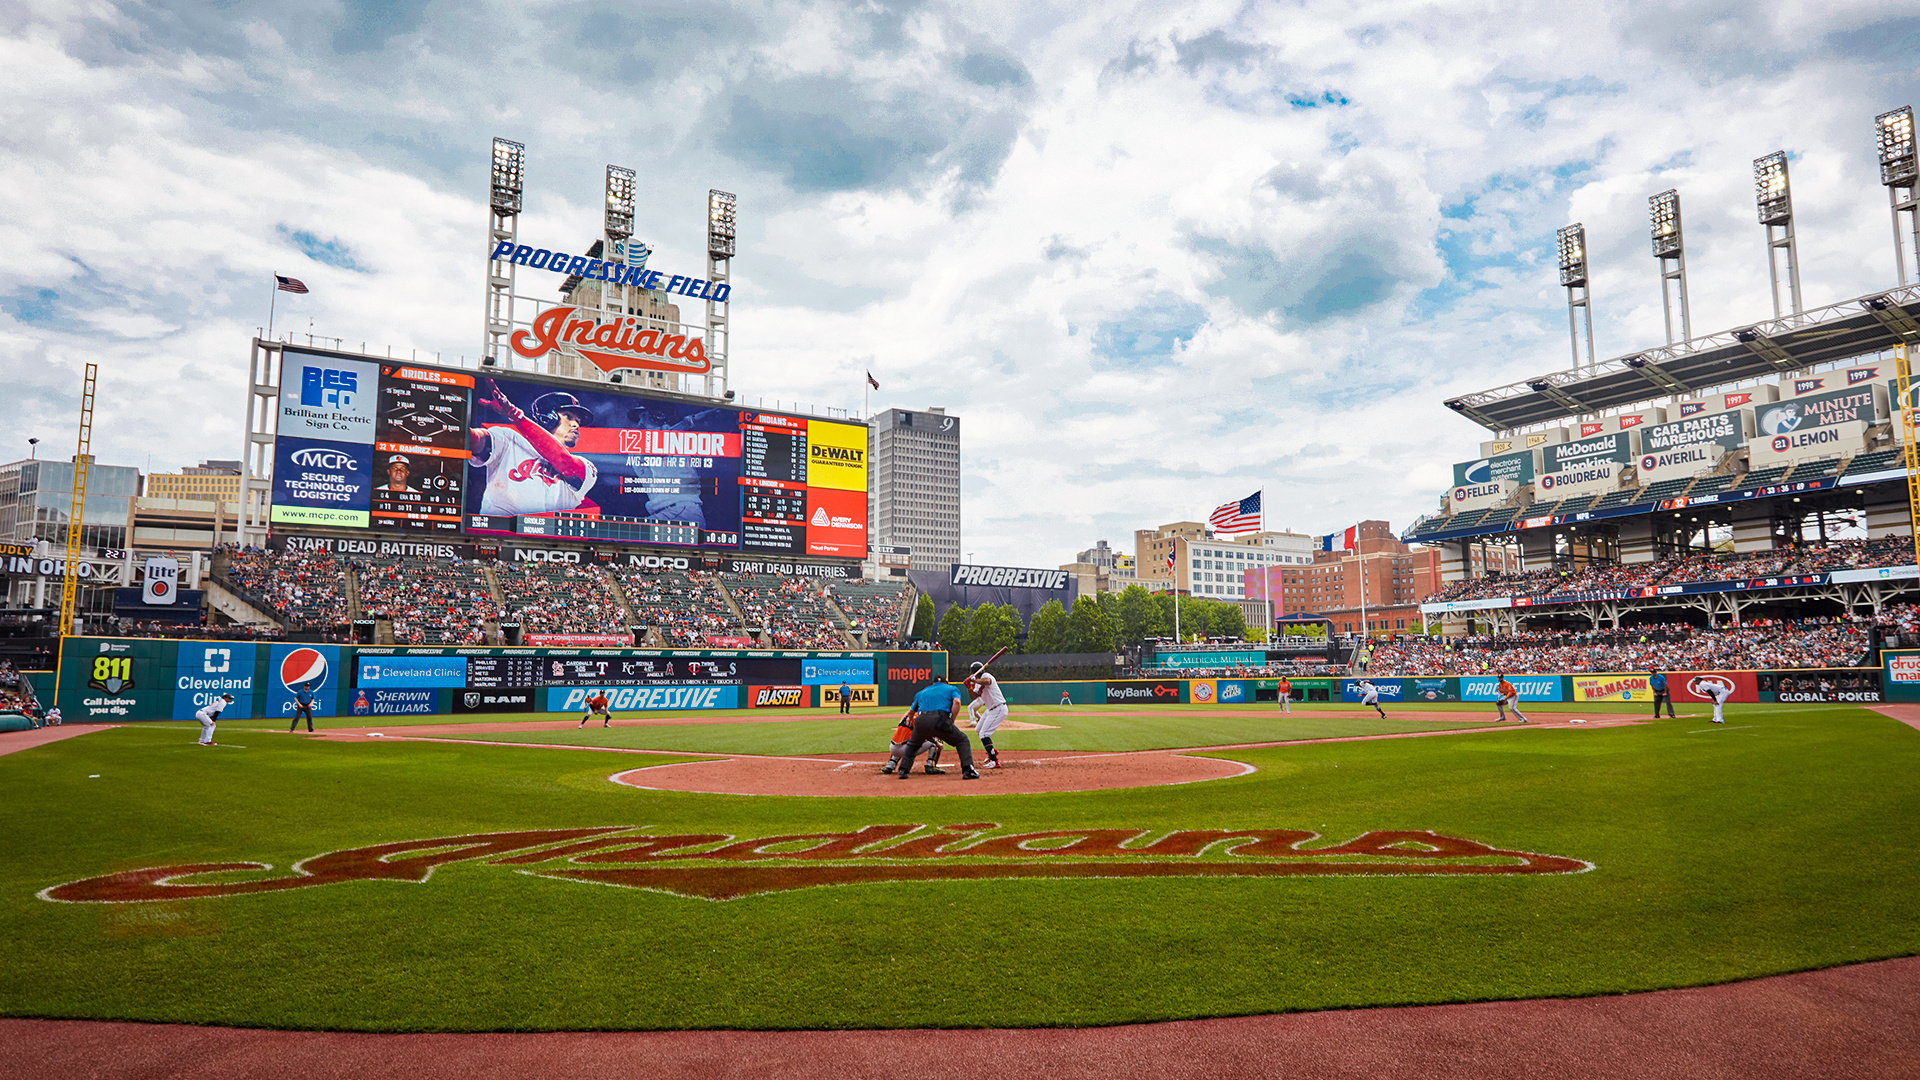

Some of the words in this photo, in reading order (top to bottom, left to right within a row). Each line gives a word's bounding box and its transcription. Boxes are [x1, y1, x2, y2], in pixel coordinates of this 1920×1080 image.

[490, 240, 664, 290] PROGRESSIVE
[665, 274, 732, 303] FIELD
[510, 306, 711, 374] Indians
[401, 368, 440, 382] ORIOLES
[1850, 370, 1868, 380] 1999
[1797, 381, 1815, 390] 1998
[1726, 395, 1742, 405] 1997
[1804, 392, 1872, 416] MINUTE
[284, 406, 329, 420] Brilliant
[331, 411, 372, 425] Electric
[1682, 404, 1697, 414] 1996
[759, 414, 787, 426] INDIANS
[1621, 418, 1636, 426] 1995
[1819, 407, 1858, 426] MEN
[305, 418, 330, 432] Sign
[332, 421, 350, 432] Co.
[939, 418, 954, 432] 9
[1583, 425, 1596, 433] 1954
[1652, 424, 1680, 438] CAR
[1683, 414, 1729, 432] PARTS
[618, 429, 642, 453] 12
[651, 431, 725, 456] LINDOR
[1650, 424, 1734, 448] WAREHOUSE
[1775, 439, 1787, 449] 21
[1791, 428, 1839, 448] LEMON
[1556, 435, 1616, 458] McDonald
[626, 456, 641, 467] AVG
[641, 457, 662, 468] .300
[666, 457, 677, 467] HR
[679, 457, 685, 467] 5
[690, 457, 702, 468] RBI
[703, 458, 713, 468] 13
[811, 459, 844, 467] GUARANTEED
[1490, 458, 1521, 469] electronic
[1645, 459, 1652, 467] 3
[1658, 449, 1707, 467] AVERILL
[1490, 464, 1521, 475] merchant
[1545, 478, 1551, 486] 5
[1556, 467, 1610, 486] BOUDREAU
[301, 472, 345, 483] SECURE
[284, 480, 360, 494] TECHNOLOGY
[1456, 490, 1464, 499] 19
[1467, 484, 1500, 498] FELLER
[293, 489, 351, 502] LOGISTICS
[282, 510, 359, 521] www.mcpc.com
[524, 517, 546, 525] ORIOLES
[523, 526, 545, 534] INDIANS
[831, 522, 863, 530] DENNISON
[286, 536, 335, 552] START
[338, 539, 377, 554] DEAD
[514, 549, 581, 564] NOCO
[629, 555, 689, 570] NOCO
[9, 557, 34, 574] IN
[38, 558, 92, 578] OHO
[147, 566, 176, 580] Lite
[732, 561, 764, 573] START
[766, 563, 793, 575] DEAD
[795, 565, 848, 578] BATTERIES.
[953, 565, 1068, 589] PROGRESSIVE
[1644, 587, 1653, 596] 12
[1812, 575, 1820, 583] 13
[1182, 656, 1218, 664] MEDICAL
[1220, 656, 1253, 664] MUTUAL
[93, 656, 131, 681] 811
[382, 667, 431, 678] Cleveland
[433, 667, 461, 678] Clinic
[817, 668, 851, 676] Cleveland
[852, 668, 870, 676] Clinic
[888, 665, 932, 684] meijer
[178, 676, 252, 690] Cleveland
[1895, 672, 1920, 681] ma
[1107, 687, 1153, 699] KeyBank
[1346, 683, 1401, 694] Firsnergy
[1465, 682, 1553, 696] PROGESSIVE
[1584, 678, 1647, 699] W.B.MASON
[83, 698, 102, 706] Call
[103, 698, 136, 706] before
[193, 692, 235, 706] Clinc
[376, 690, 431, 702] SHERWIN
[483, 695, 526, 704] RAM
[563, 688, 721, 710] PROGRESSIVE
[1780, 692, 1827, 702] GLOBAL
[1838, 692, 1880, 702] POKER
[89, 707, 109, 715] you
[110, 706, 129, 715] dig.
[282, 699, 322, 714] pesi
[373, 702, 432, 714] WILLIAMS.
[36, 822, 1596, 904] Indians
